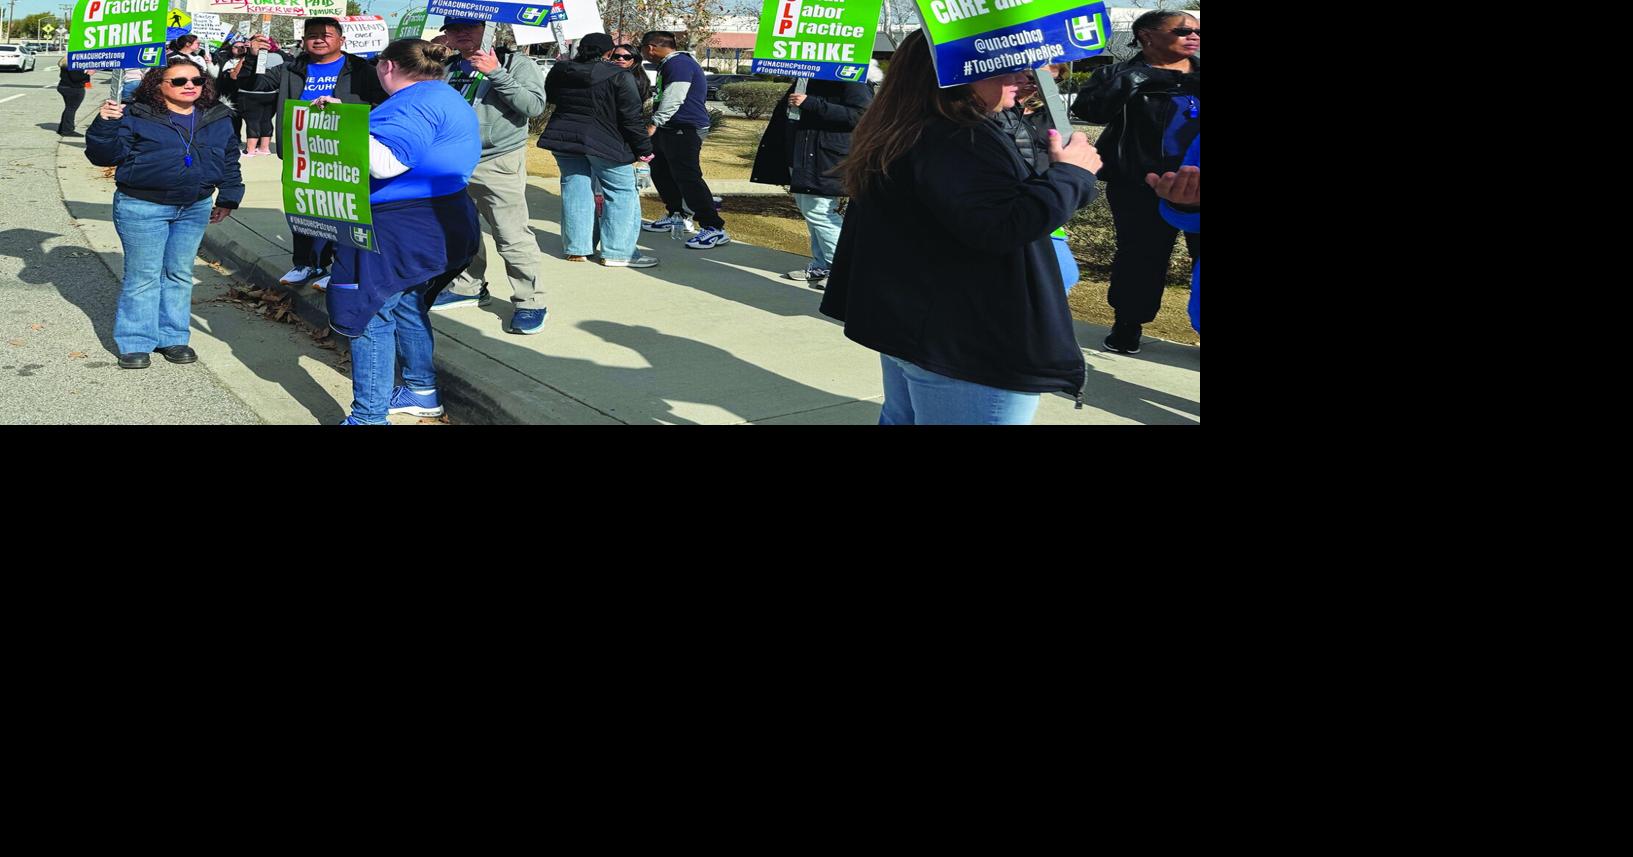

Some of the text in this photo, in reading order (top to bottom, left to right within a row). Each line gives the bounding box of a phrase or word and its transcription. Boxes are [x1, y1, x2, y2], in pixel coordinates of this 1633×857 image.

[430, 7, 493, 20] #TogetherWeWin
[432, 0, 499, 13] #UNACUHCPstrong
[783, 3, 845, 19] Labor
[931, 0, 990, 24] CARE
[83, 20, 153, 48] STRIKE
[341, 23, 385, 33] PATIENTS
[779, 19, 865, 38] Practice
[344, 39, 383, 50] PROFIT
[974, 28, 1044, 53] @unacuhcp
[772, 40, 855, 62] STRIKE
[963, 42, 1064, 76] #TogetherWeRise
[72, 60, 121, 69] #TogetherWeWin
[756, 67, 815, 78] #TogetherWeWin
[757, 60, 821, 72] #UNACUHCPstrong
[317, 75, 338, 83] ARE
[296, 109, 341, 131] Unfair
[296, 133, 340, 156] Labor
[296, 157, 360, 184] Practice
[294, 188, 359, 221] STRIKE
